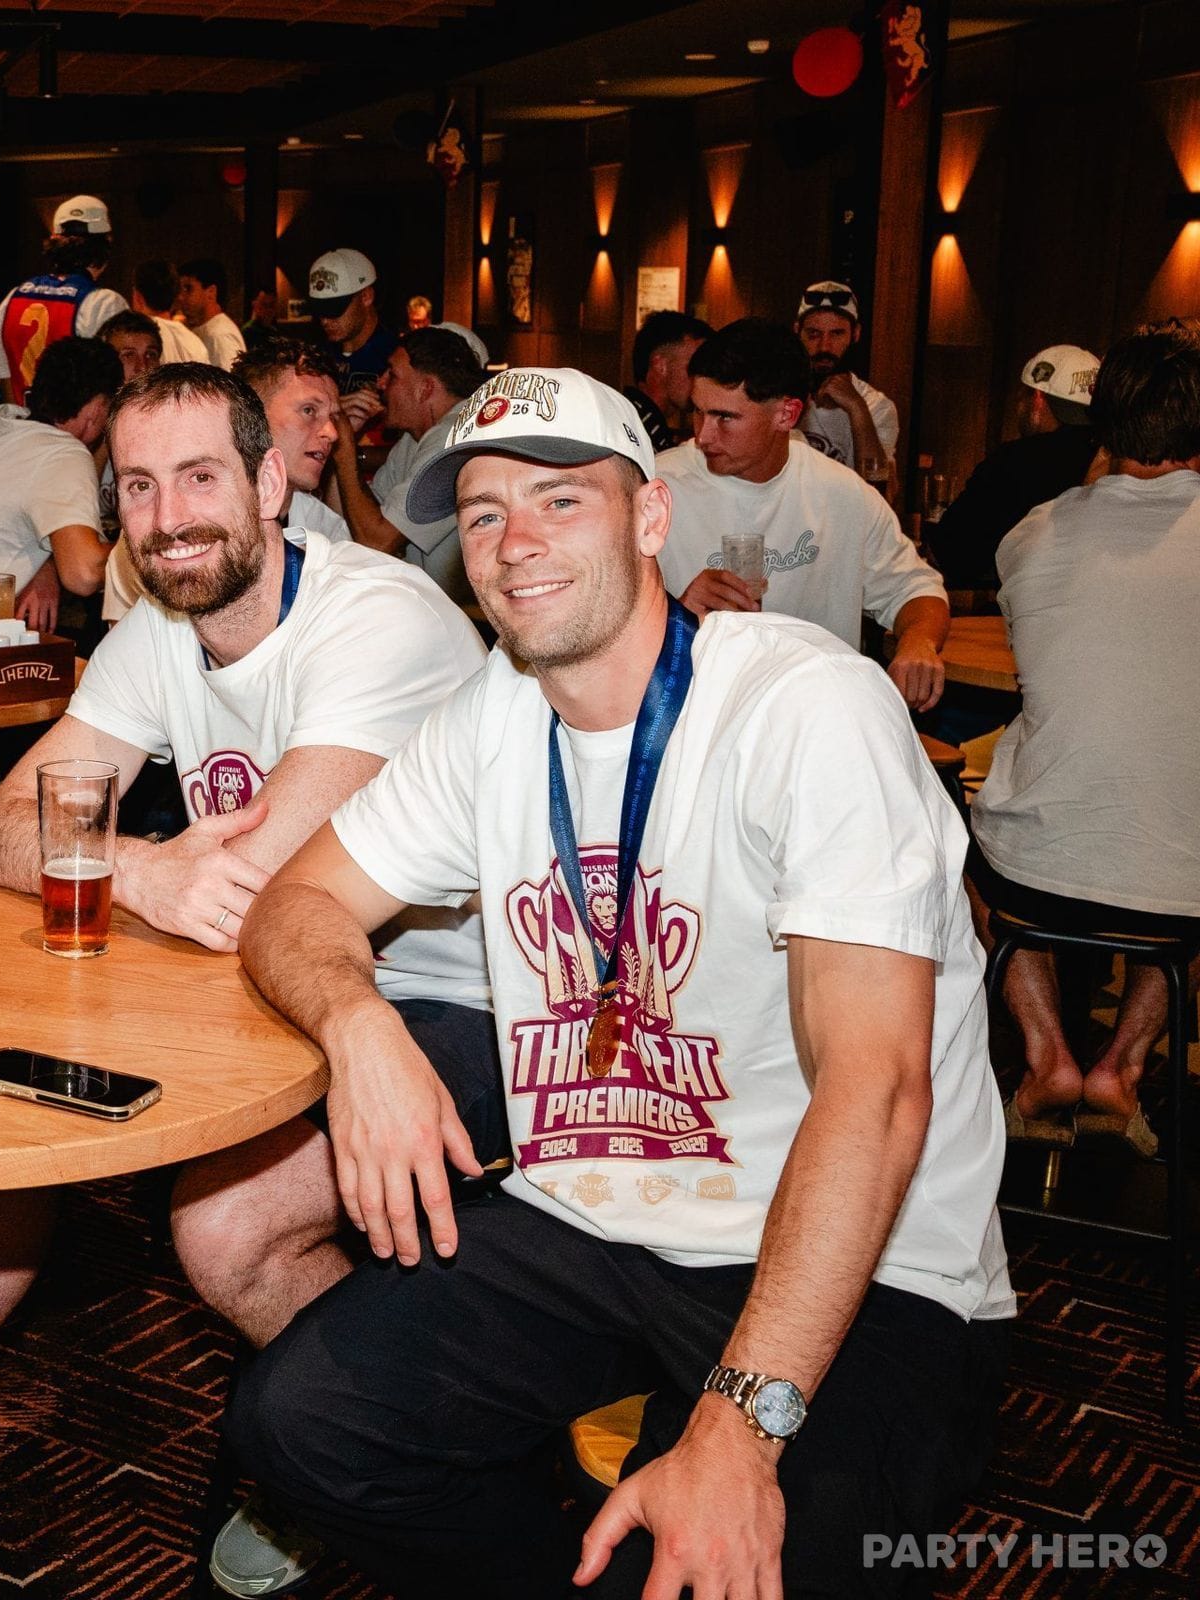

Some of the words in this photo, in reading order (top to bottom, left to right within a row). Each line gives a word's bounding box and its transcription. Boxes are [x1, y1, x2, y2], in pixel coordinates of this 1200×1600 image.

[512, 403, 529, 415] 26
[6, 665, 48, 682] HEINZ
[212, 772, 245, 790] LIONS
[543, 1086, 700, 1132] PREMIERS
[539, 1137, 578, 1159] 2024
[608, 1136, 645, 1156] 2025
[668, 1135, 708, 1155] 2026
